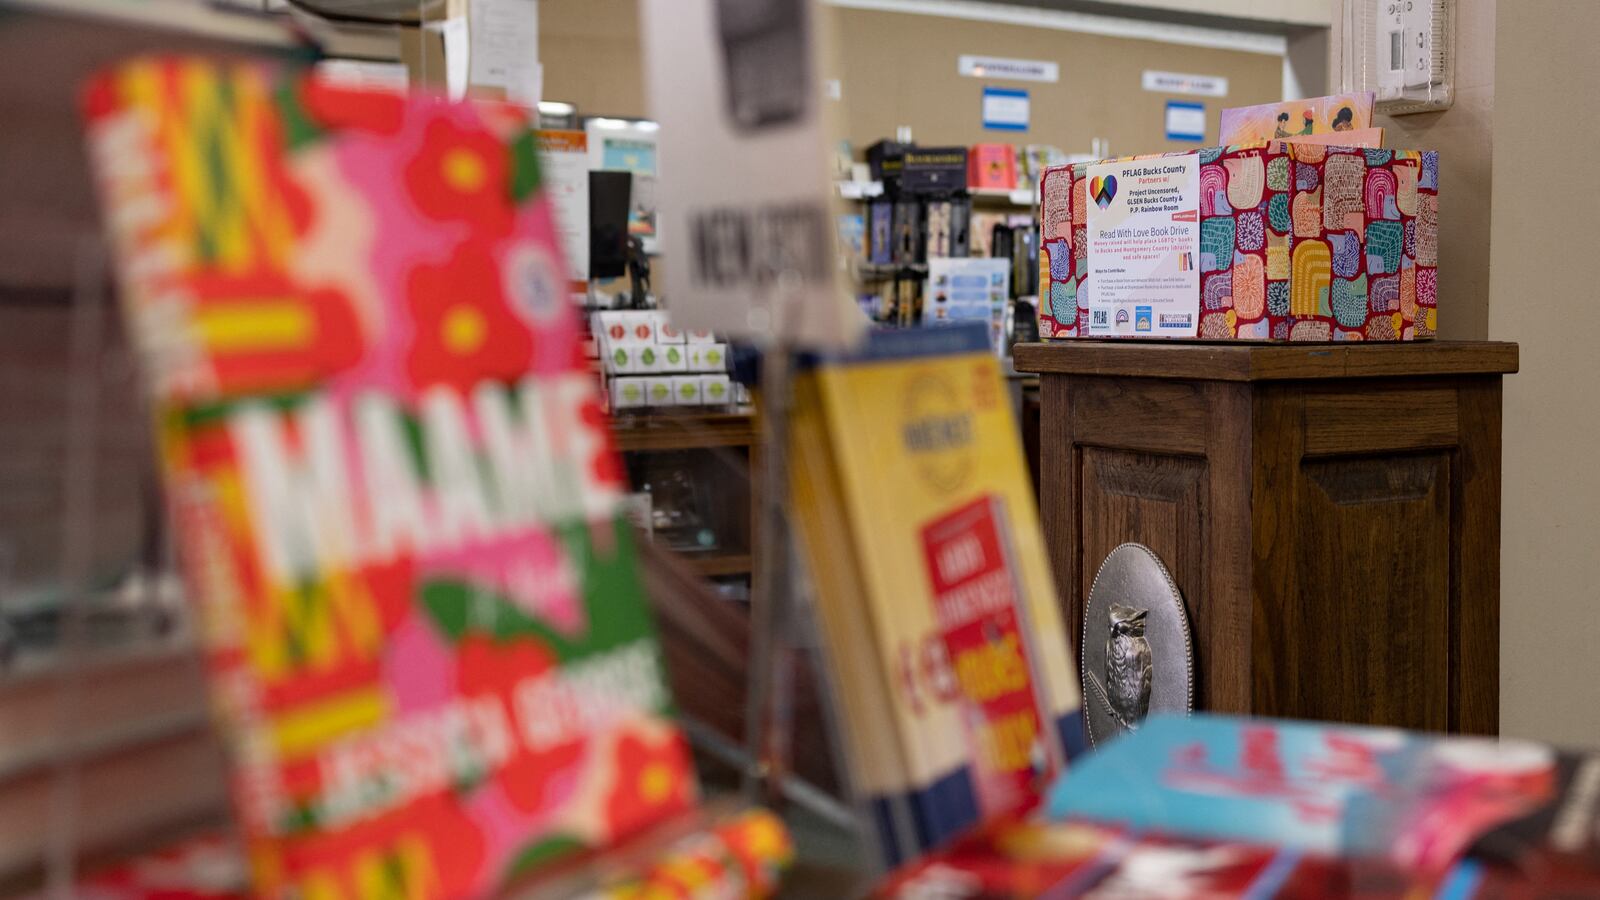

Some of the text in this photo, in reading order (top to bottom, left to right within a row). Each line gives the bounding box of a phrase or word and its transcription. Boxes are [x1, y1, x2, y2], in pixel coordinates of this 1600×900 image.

[1122, 165, 1186, 177] PFLAG Bucks County
[1129, 186, 1180, 197] Project Uncensored,
[1127, 197, 1143, 205] GLSEN
[1160, 195, 1178, 204] County
[1099, 225, 1189, 239] Read With Love Book Drive
[1094, 310, 1107, 324] PFLAG
